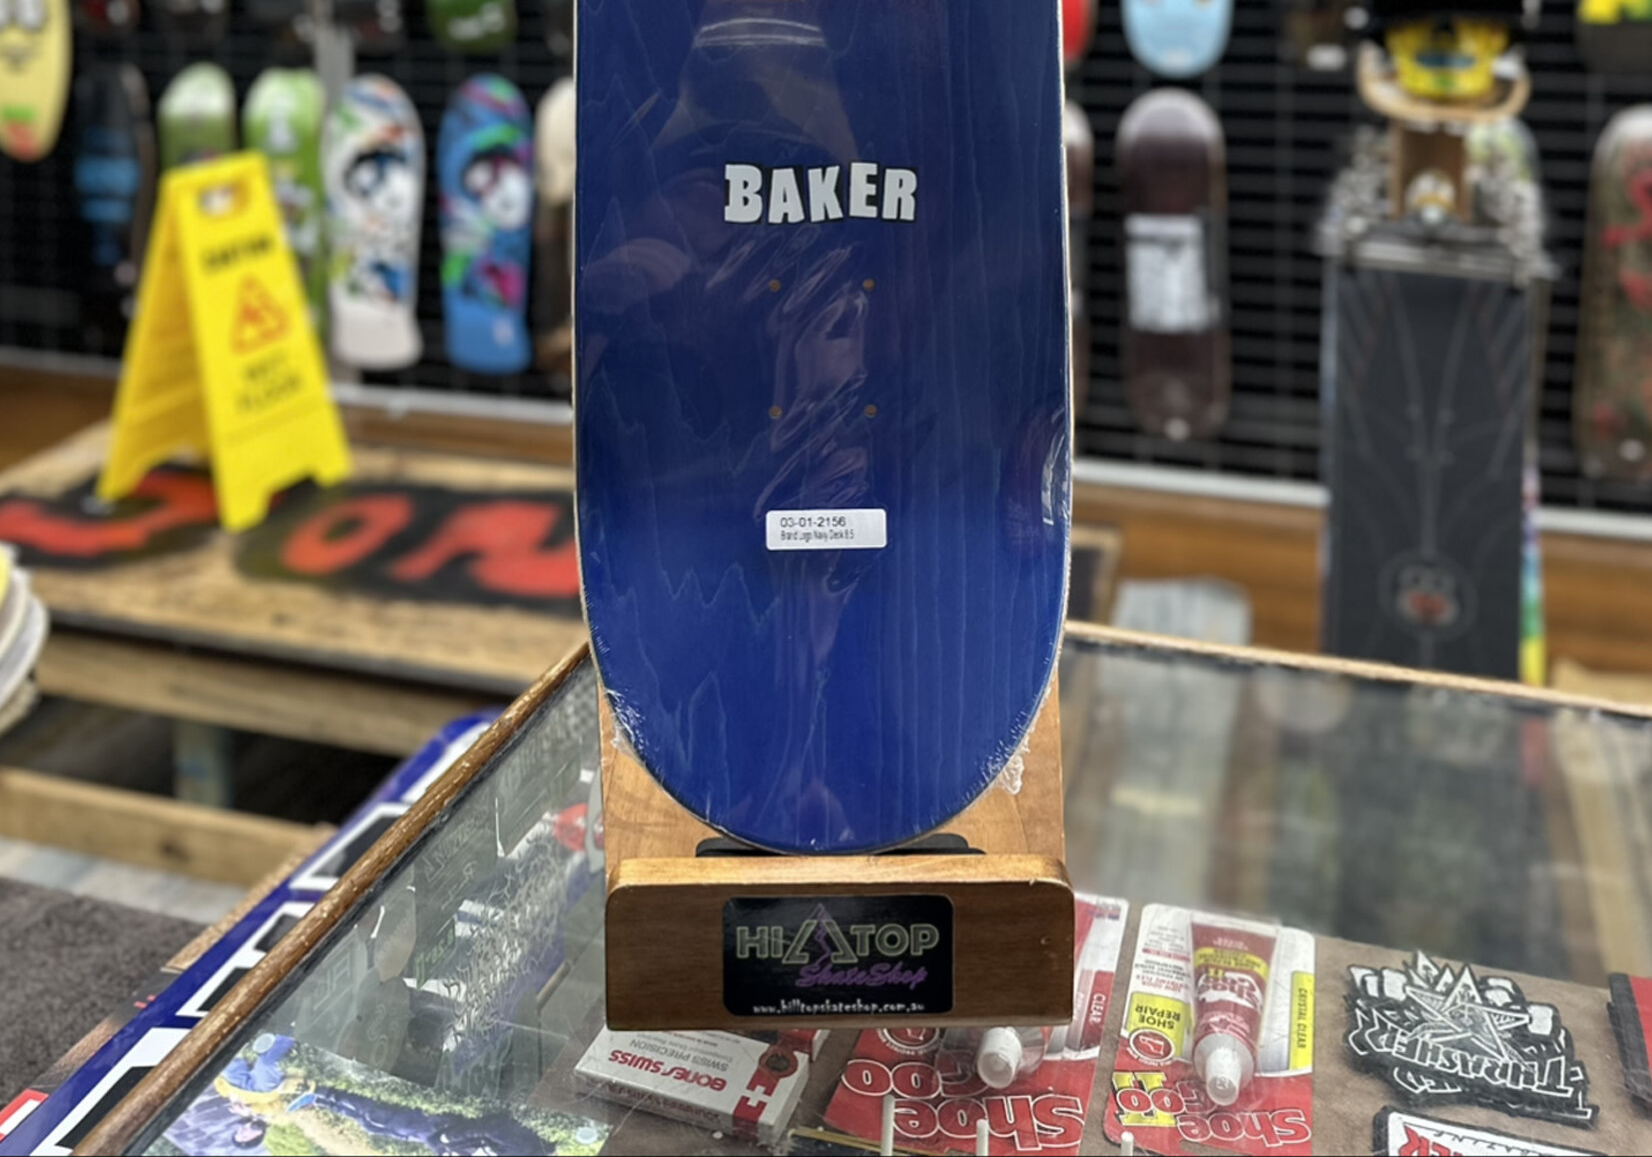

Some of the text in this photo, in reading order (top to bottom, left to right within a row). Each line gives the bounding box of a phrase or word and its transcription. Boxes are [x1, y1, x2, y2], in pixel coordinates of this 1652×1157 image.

[724, 161, 918, 224] BAKER
[780, 515, 847, 528] 03-01-2156
[753, 998, 925, 1015] www.hilltopskateshop.com.au
[1089, 993, 1107, 1024] CLEAR
[1135, 1005, 1181, 1022] REPAIR
[1138, 1014, 1175, 1030] SHOE
[1297, 988, 1308, 1049] CRYSTAL CLEAR
[630, 1038, 691, 1063] PRECISION
[1365, 1009, 1574, 1097] THRASHER
[608, 1049, 727, 1092] BONES SWISS
[892, 1094, 1084, 1151] Shoe
[1177, 1109, 1312, 1147] Shoe
